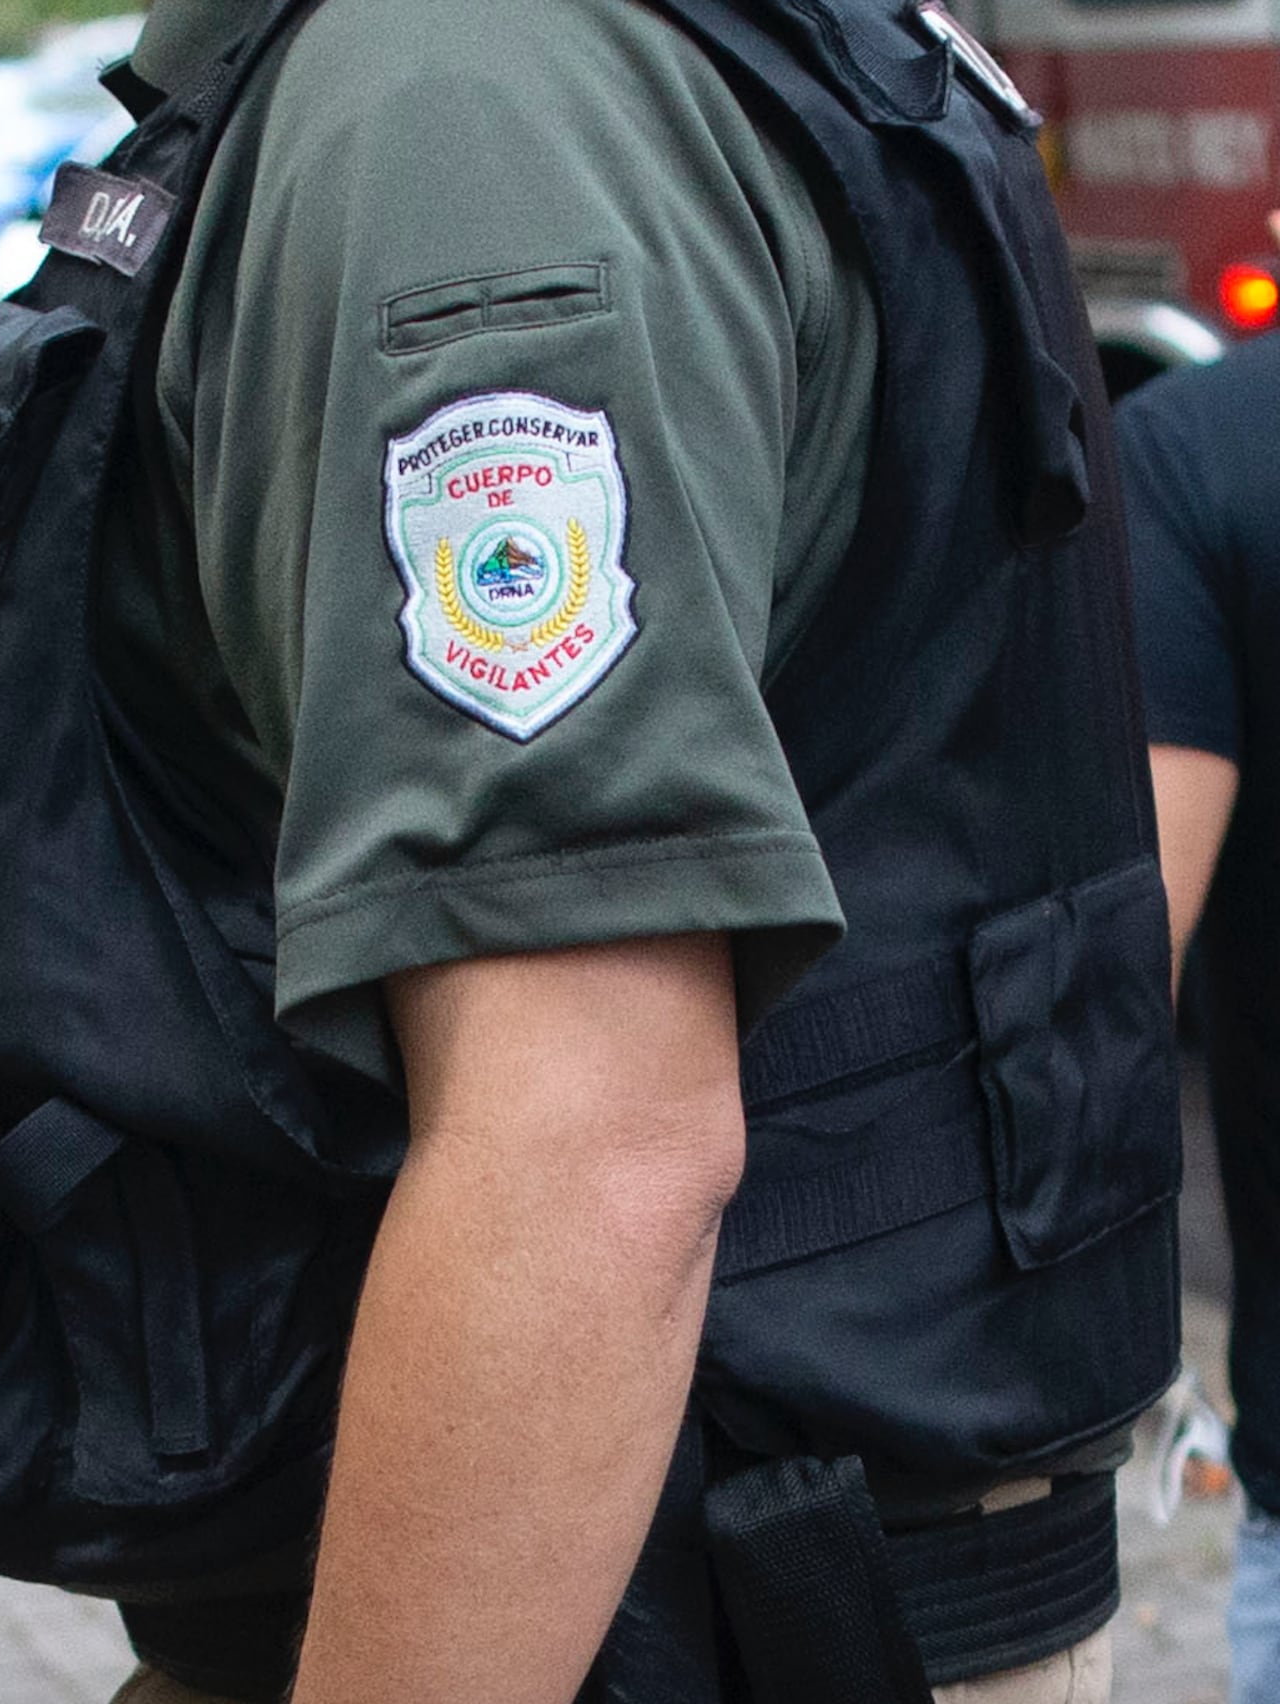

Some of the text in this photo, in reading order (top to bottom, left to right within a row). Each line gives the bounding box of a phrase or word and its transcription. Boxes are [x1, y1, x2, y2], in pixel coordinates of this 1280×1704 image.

[397, 416, 599, 476] PROTEGER CONSERVAR
[447, 464, 552, 500] CUERPO
[487, 489, 514, 508] DE
[489, 583, 534, 601] DRNA
[446, 623, 595, 692] VIGILANTES
